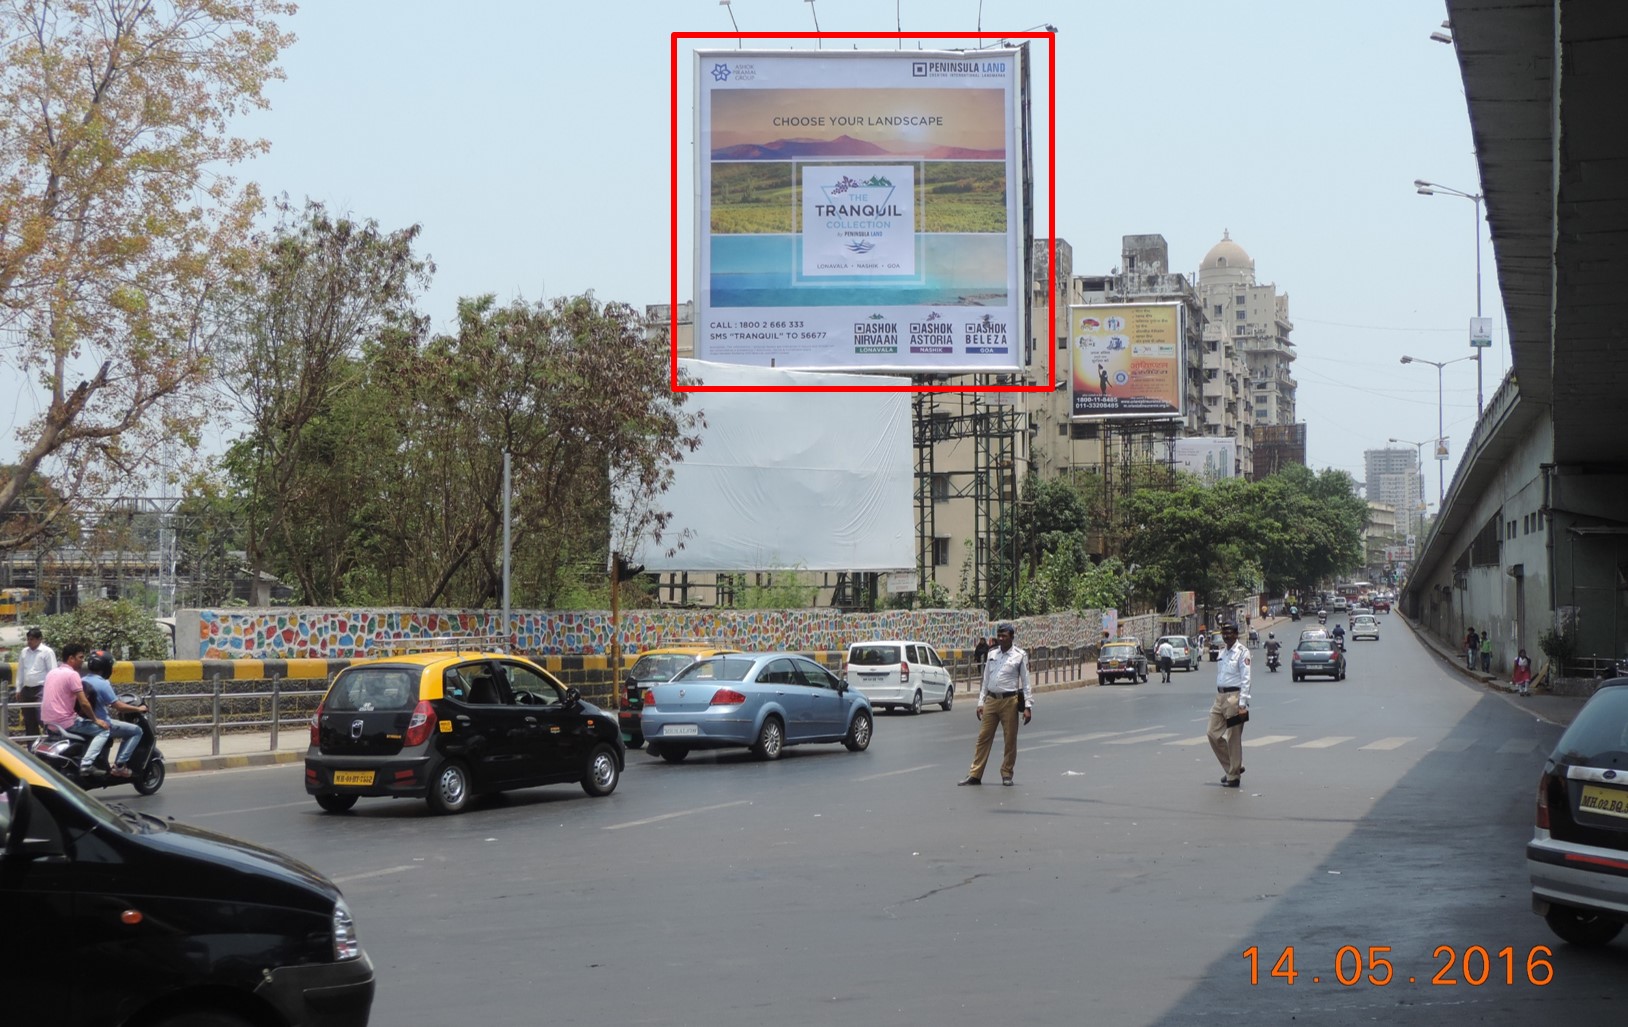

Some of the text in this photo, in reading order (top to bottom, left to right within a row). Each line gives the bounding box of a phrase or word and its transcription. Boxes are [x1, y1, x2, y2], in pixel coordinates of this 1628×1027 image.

[929, 62, 1006, 73] PENINSULA LAND
[773, 116, 943, 127] CHOOSE YOUR LANDSCAPE
[849, 194, 868, 202] THE
[815, 205, 902, 217] TRANQUIL
[826, 221, 891, 229] COLLECTION
[865, 323, 897, 334] ASHOK
[921, 323, 952, 334] ASHOK
[977, 323, 1006, 334] ASHOK
[854, 335, 898, 345] NIRVAAN
[910, 335, 953, 345] ASTORIA
[965, 335, 1007, 345] BELEZA
